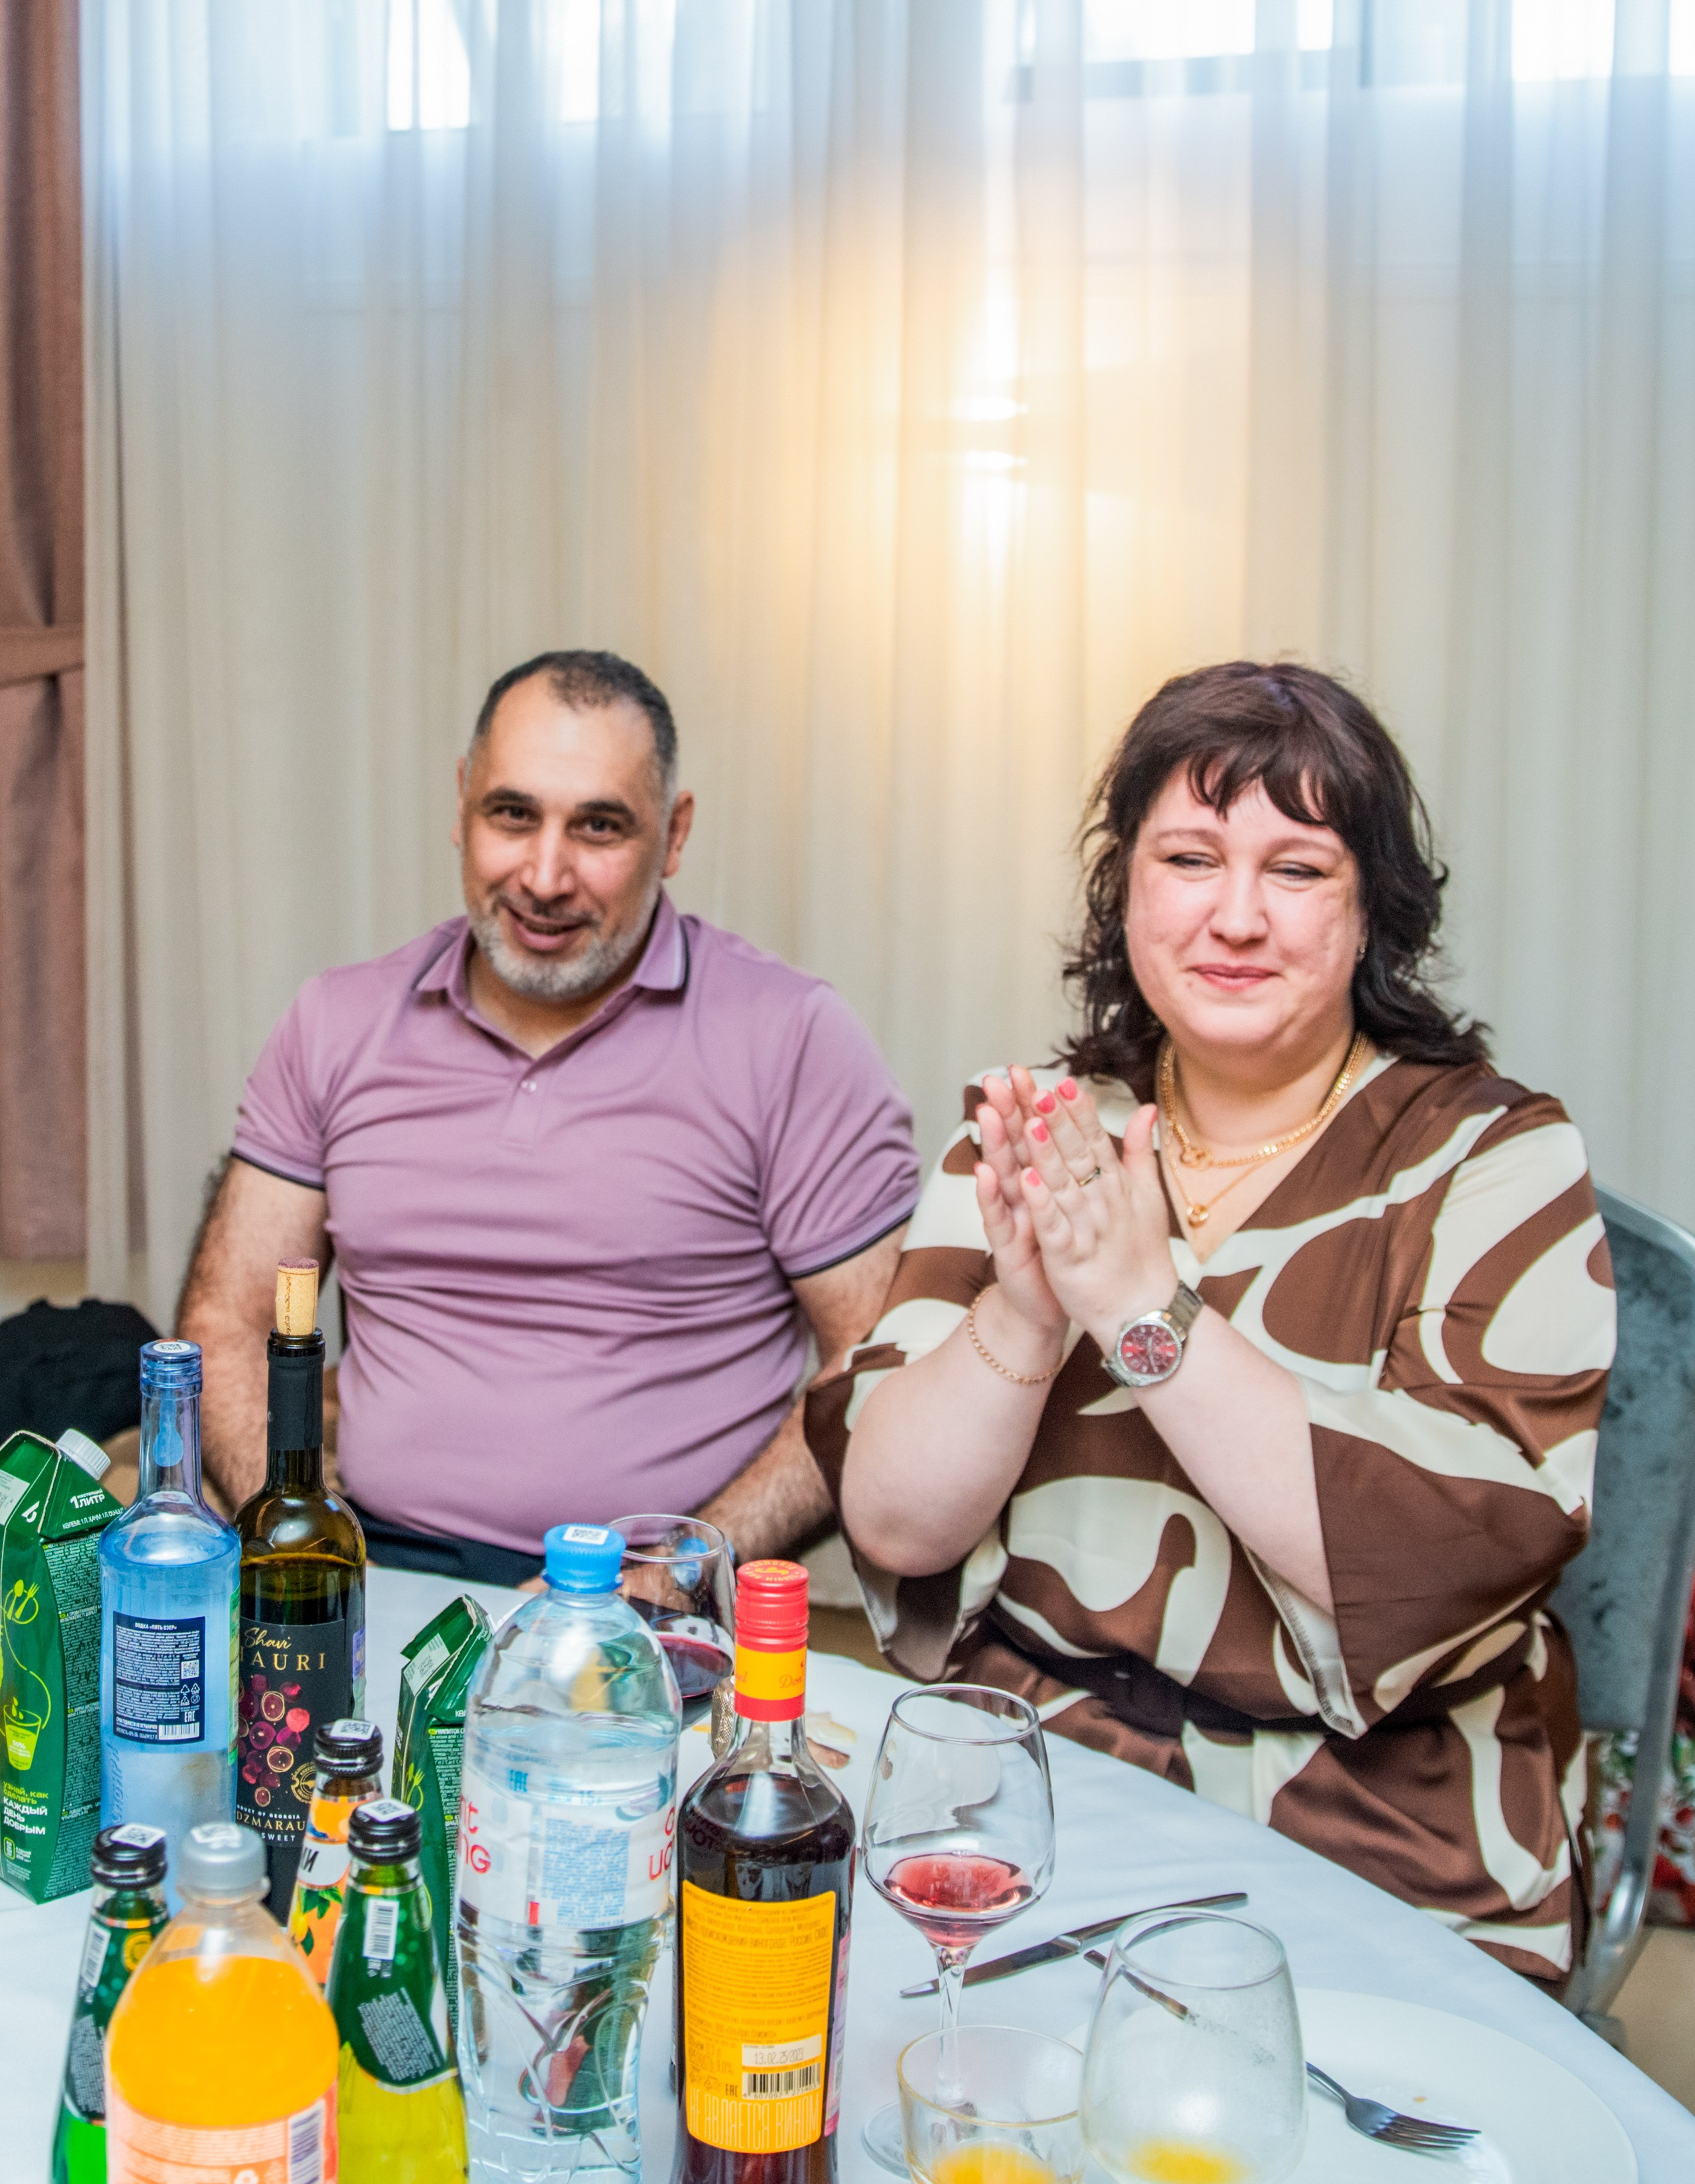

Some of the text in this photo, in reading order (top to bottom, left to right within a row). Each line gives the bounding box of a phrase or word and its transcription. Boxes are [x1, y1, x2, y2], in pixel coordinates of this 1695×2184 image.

[79, 1494, 105, 1508] ЛИТР
[244, 1627, 292, 1649] Shavi
[3, 1781, 28, 1796] узнай,
[3, 1788, 37, 1805] сделать
[3, 1797, 48, 1816] КАЖДЫЙ
[3, 1806, 25, 1823] ДЕНЬ
[3, 1816, 46, 1835] ДОБРЫМ
[261, 1832, 295, 1842] SWEET
[726, 2083, 738, 2098] EAC
[690, 2087, 820, 2151] НЕ ЯВЛЯЕТСЯ ВИНОМ
